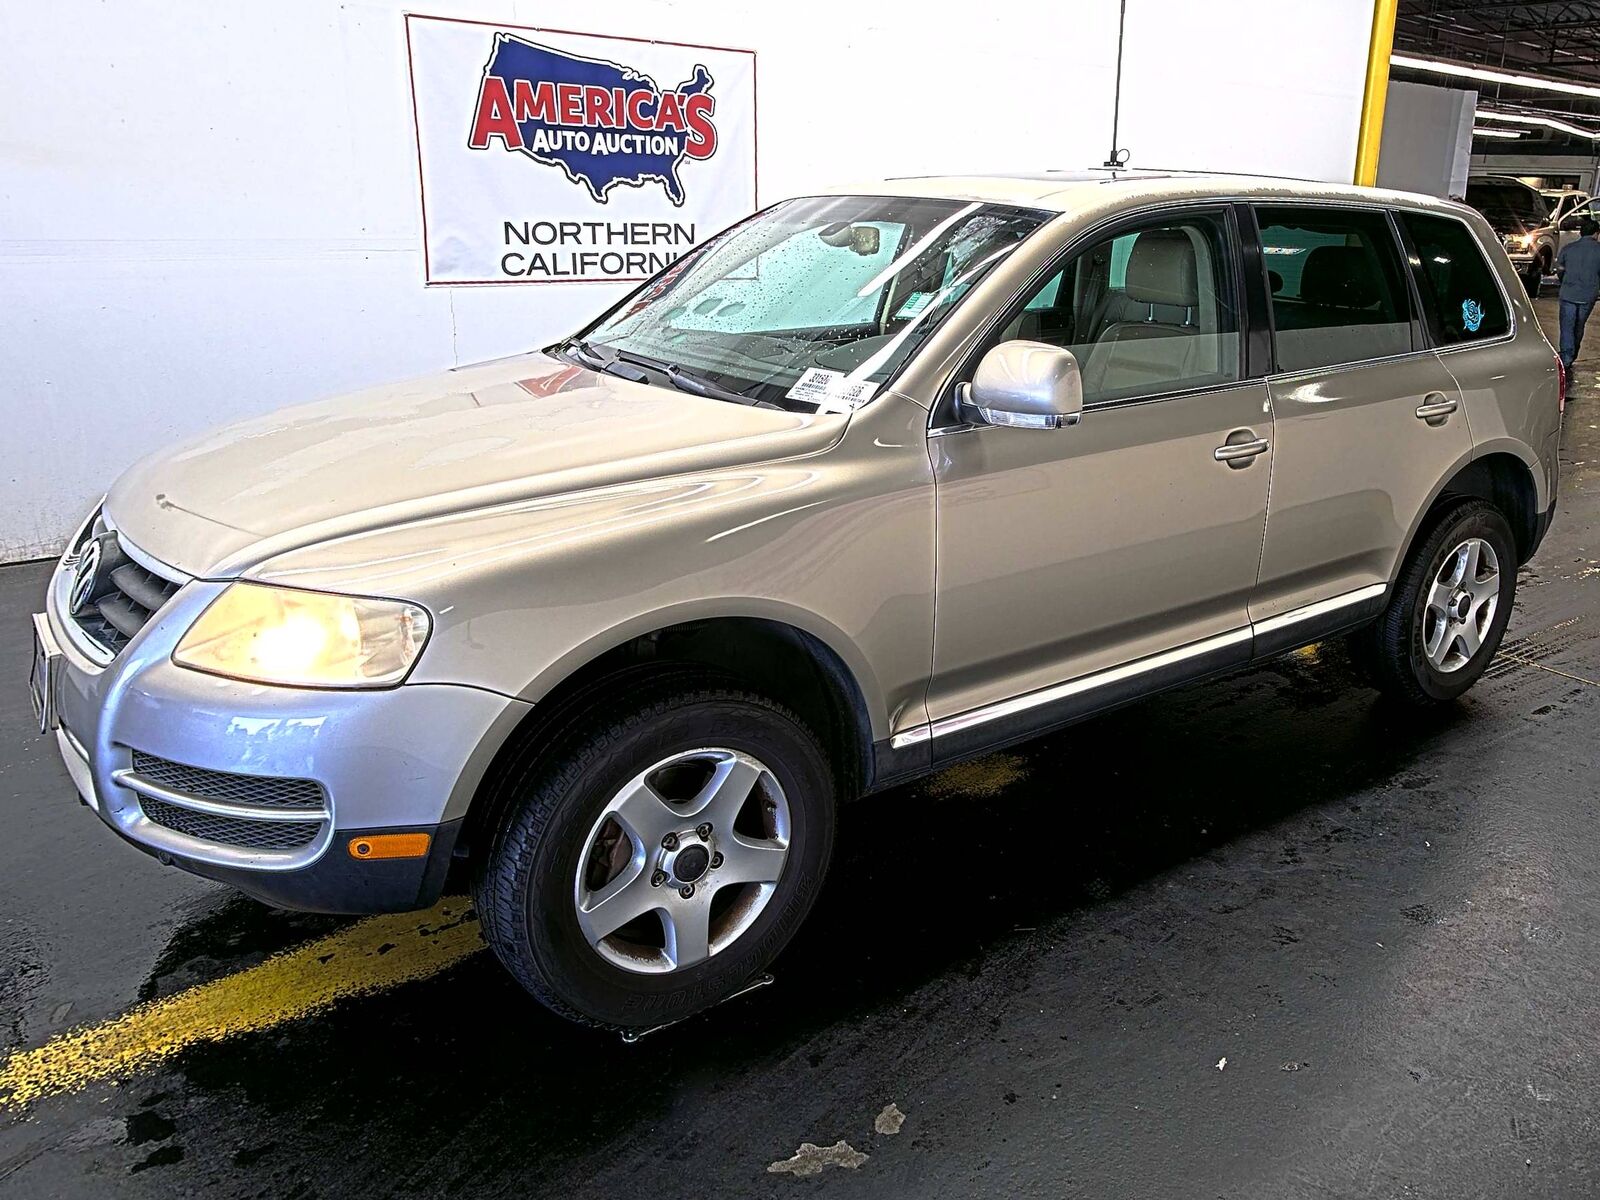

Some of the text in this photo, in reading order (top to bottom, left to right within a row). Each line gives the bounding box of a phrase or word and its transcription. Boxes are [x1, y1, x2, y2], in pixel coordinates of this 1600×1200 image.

[470, 76, 717, 159] AMERICA'S
[532, 129, 679, 156] AUTO AUCTION
[503, 221, 695, 245] NORTHERN
[501, 251, 678, 276] CALIFORN
